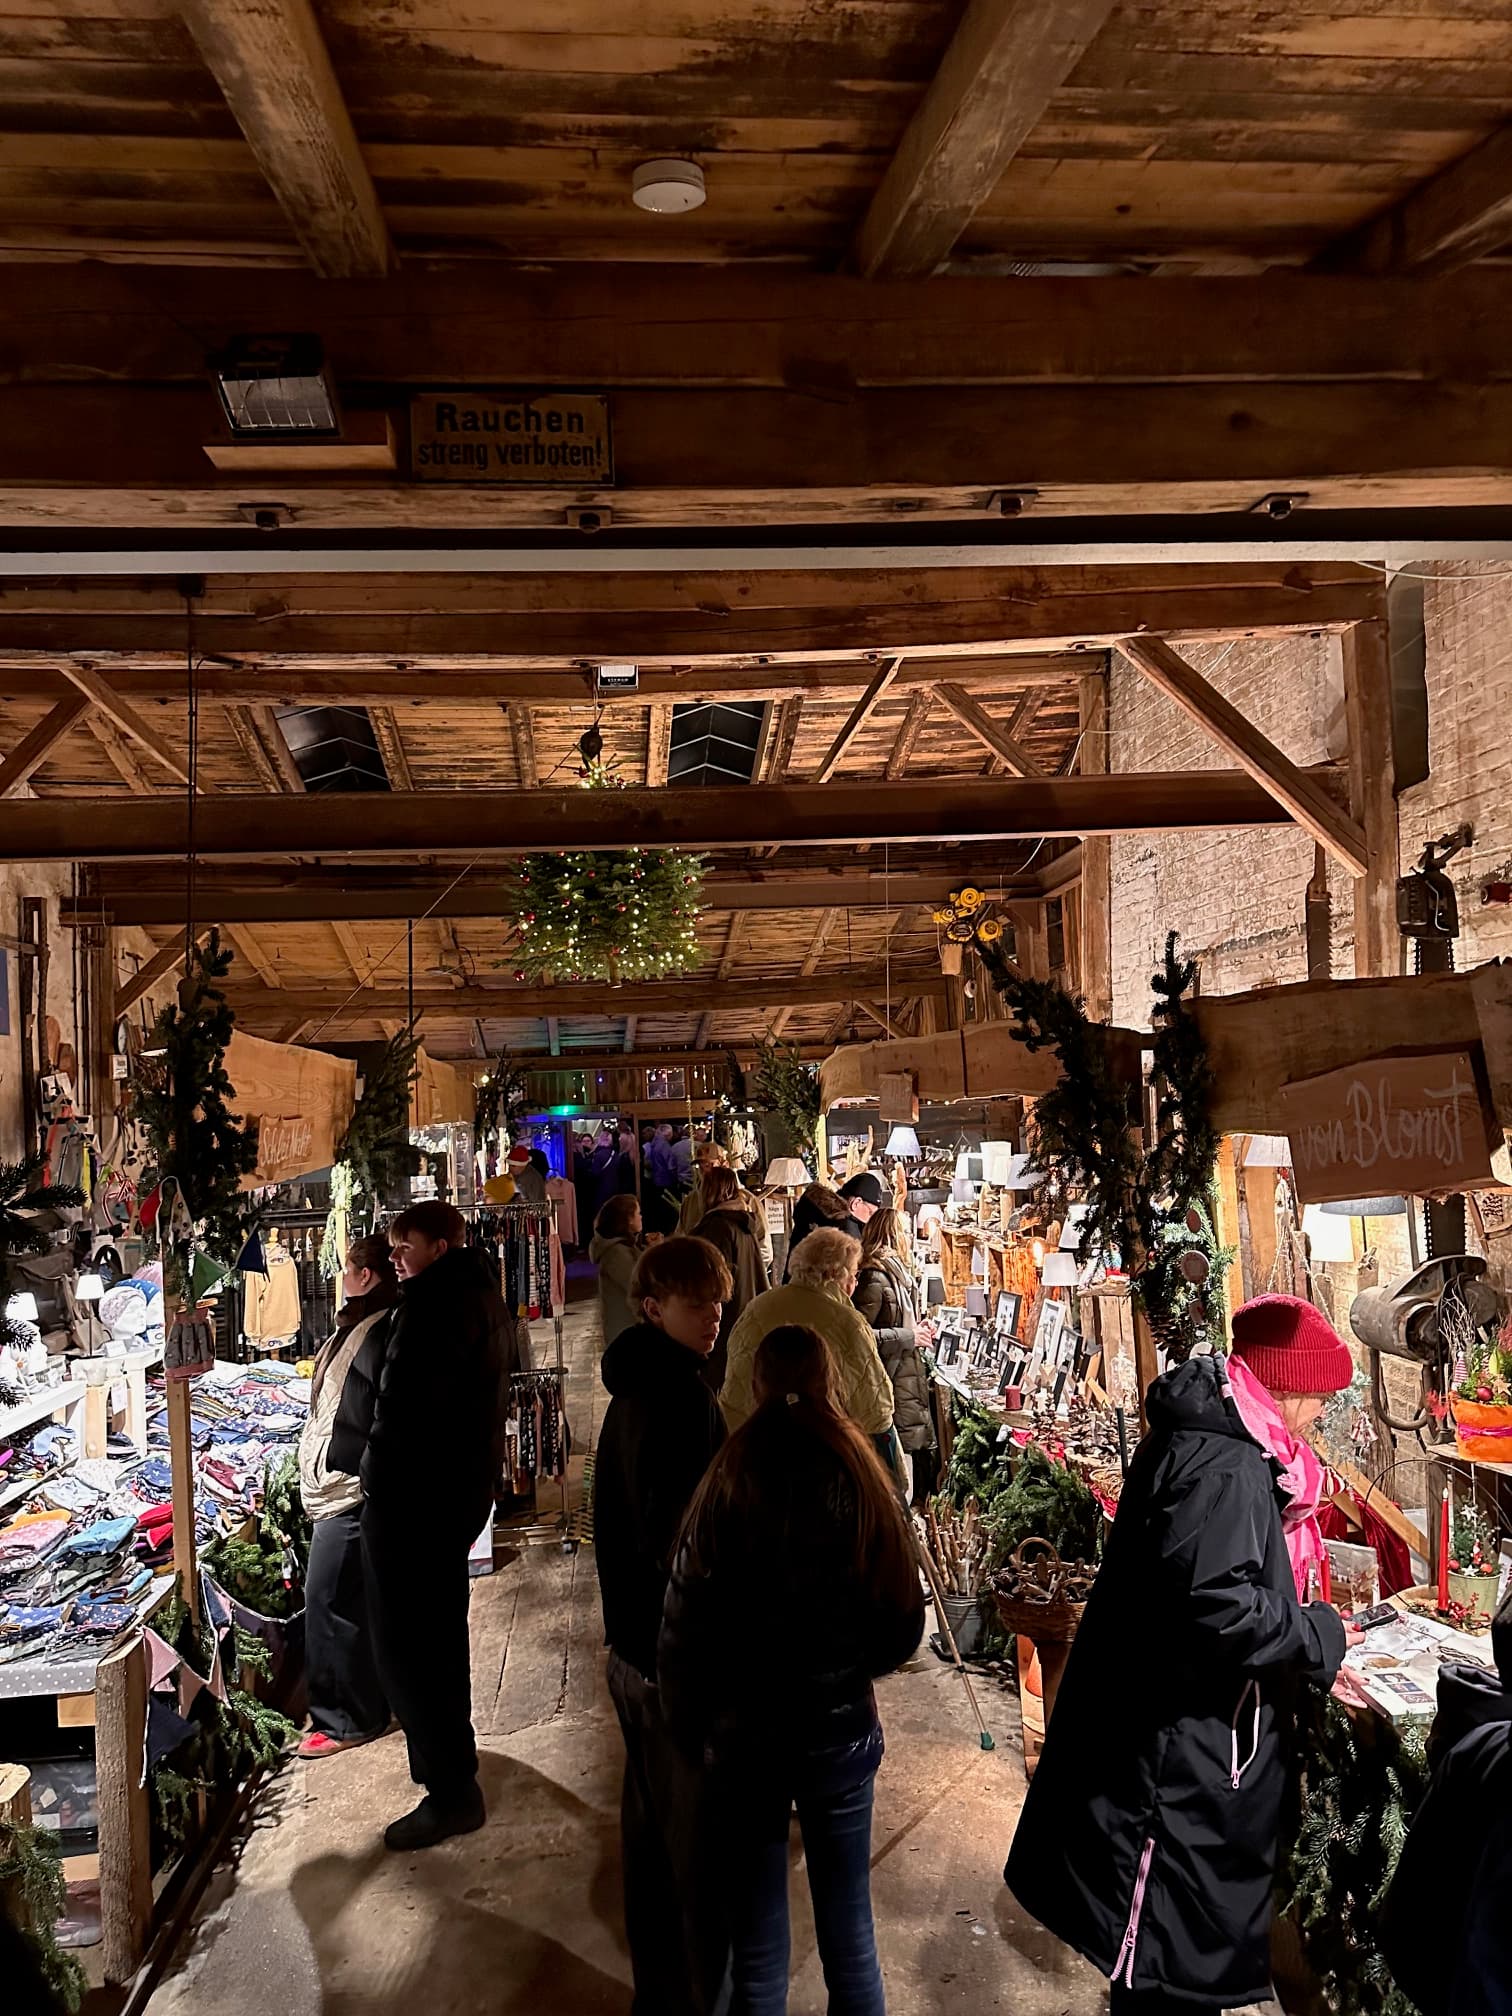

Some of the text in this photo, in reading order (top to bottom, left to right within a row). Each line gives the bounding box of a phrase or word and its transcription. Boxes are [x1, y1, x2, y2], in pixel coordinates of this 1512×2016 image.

[435, 401, 585, 433] Rauchen
[418, 436, 603, 471] streng verboten!
